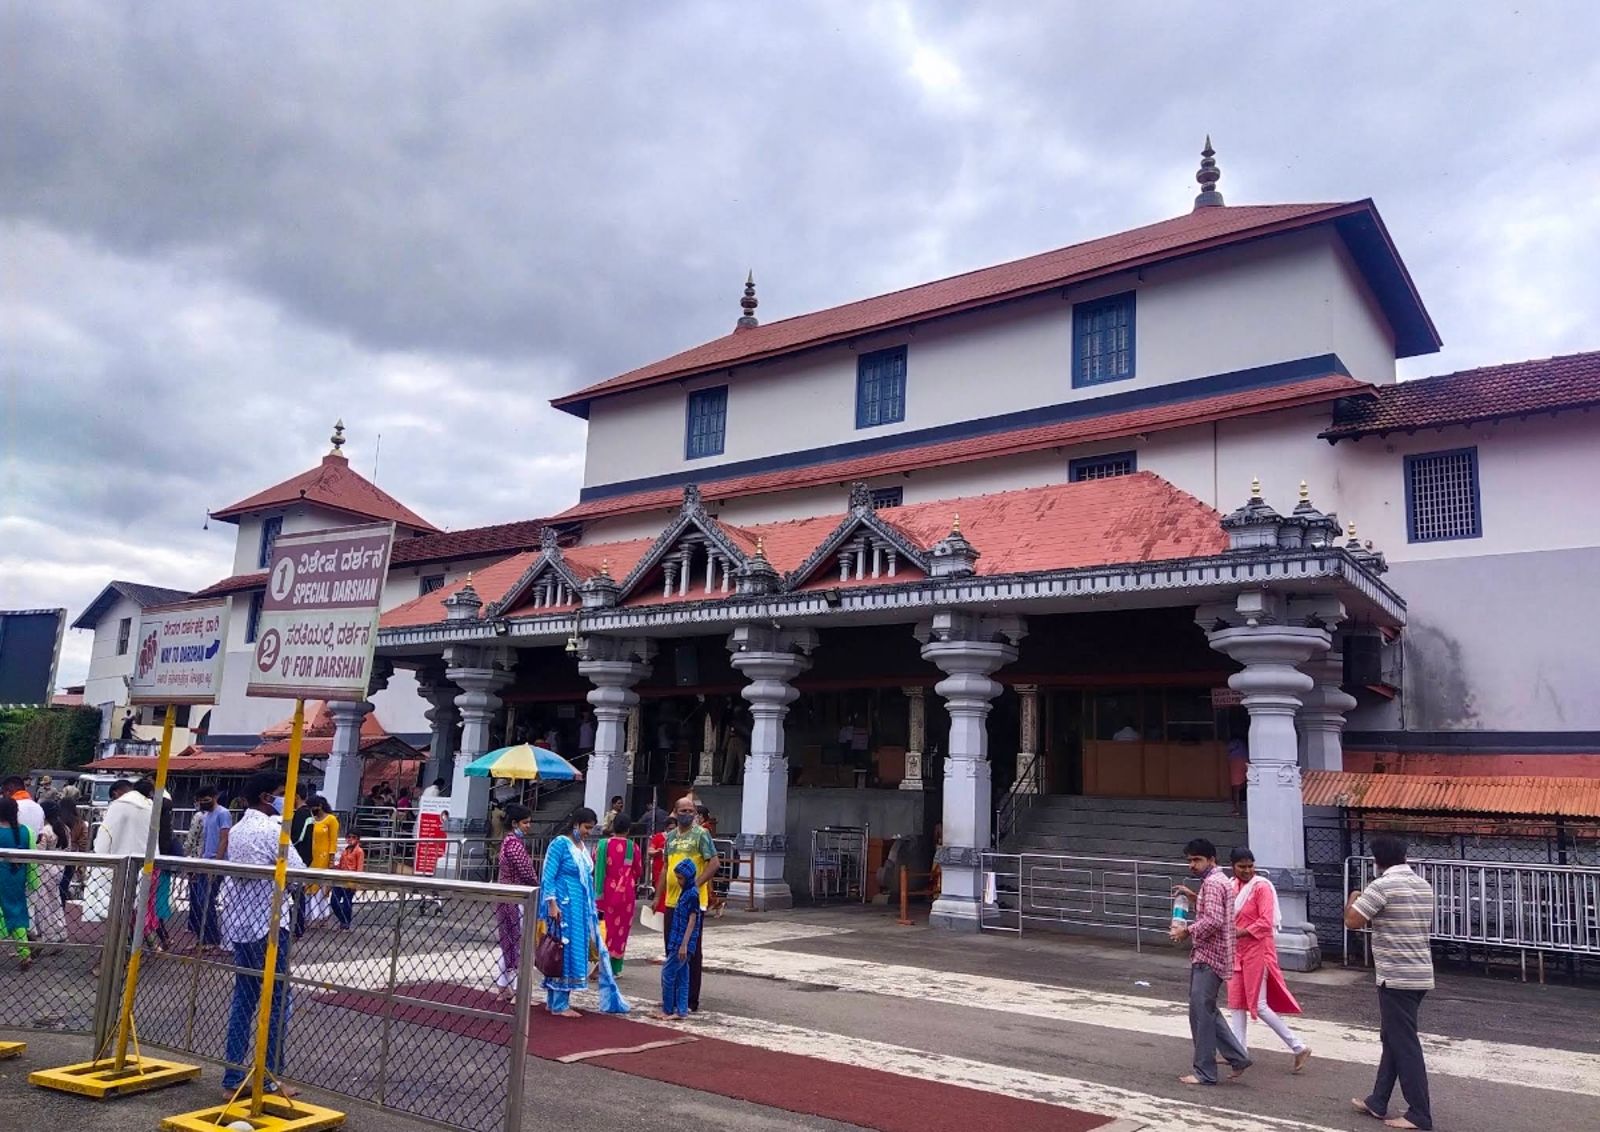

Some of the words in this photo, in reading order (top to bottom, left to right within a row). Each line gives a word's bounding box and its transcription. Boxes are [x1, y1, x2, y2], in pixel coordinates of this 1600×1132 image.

[297, 548, 338, 574] ವಿಶೇಷ
[341, 543, 385, 571] ದರ್ಶನ
[276, 563, 288, 594] 1
[293, 581, 330, 604] SPECIAL
[331, 578, 378, 602] DARSHAN
[260, 634, 277, 665] 2
[285, 622, 334, 652] ಸರತಿಯಲ್ಲಿ
[337, 622, 372, 645] ದರ್ಶನ
[172, 646, 179, 663] TO
[180, 645, 204, 663] DARSHAN
[293, 655, 314, 677] FOR
[314, 655, 365, 678] DARSHAN
